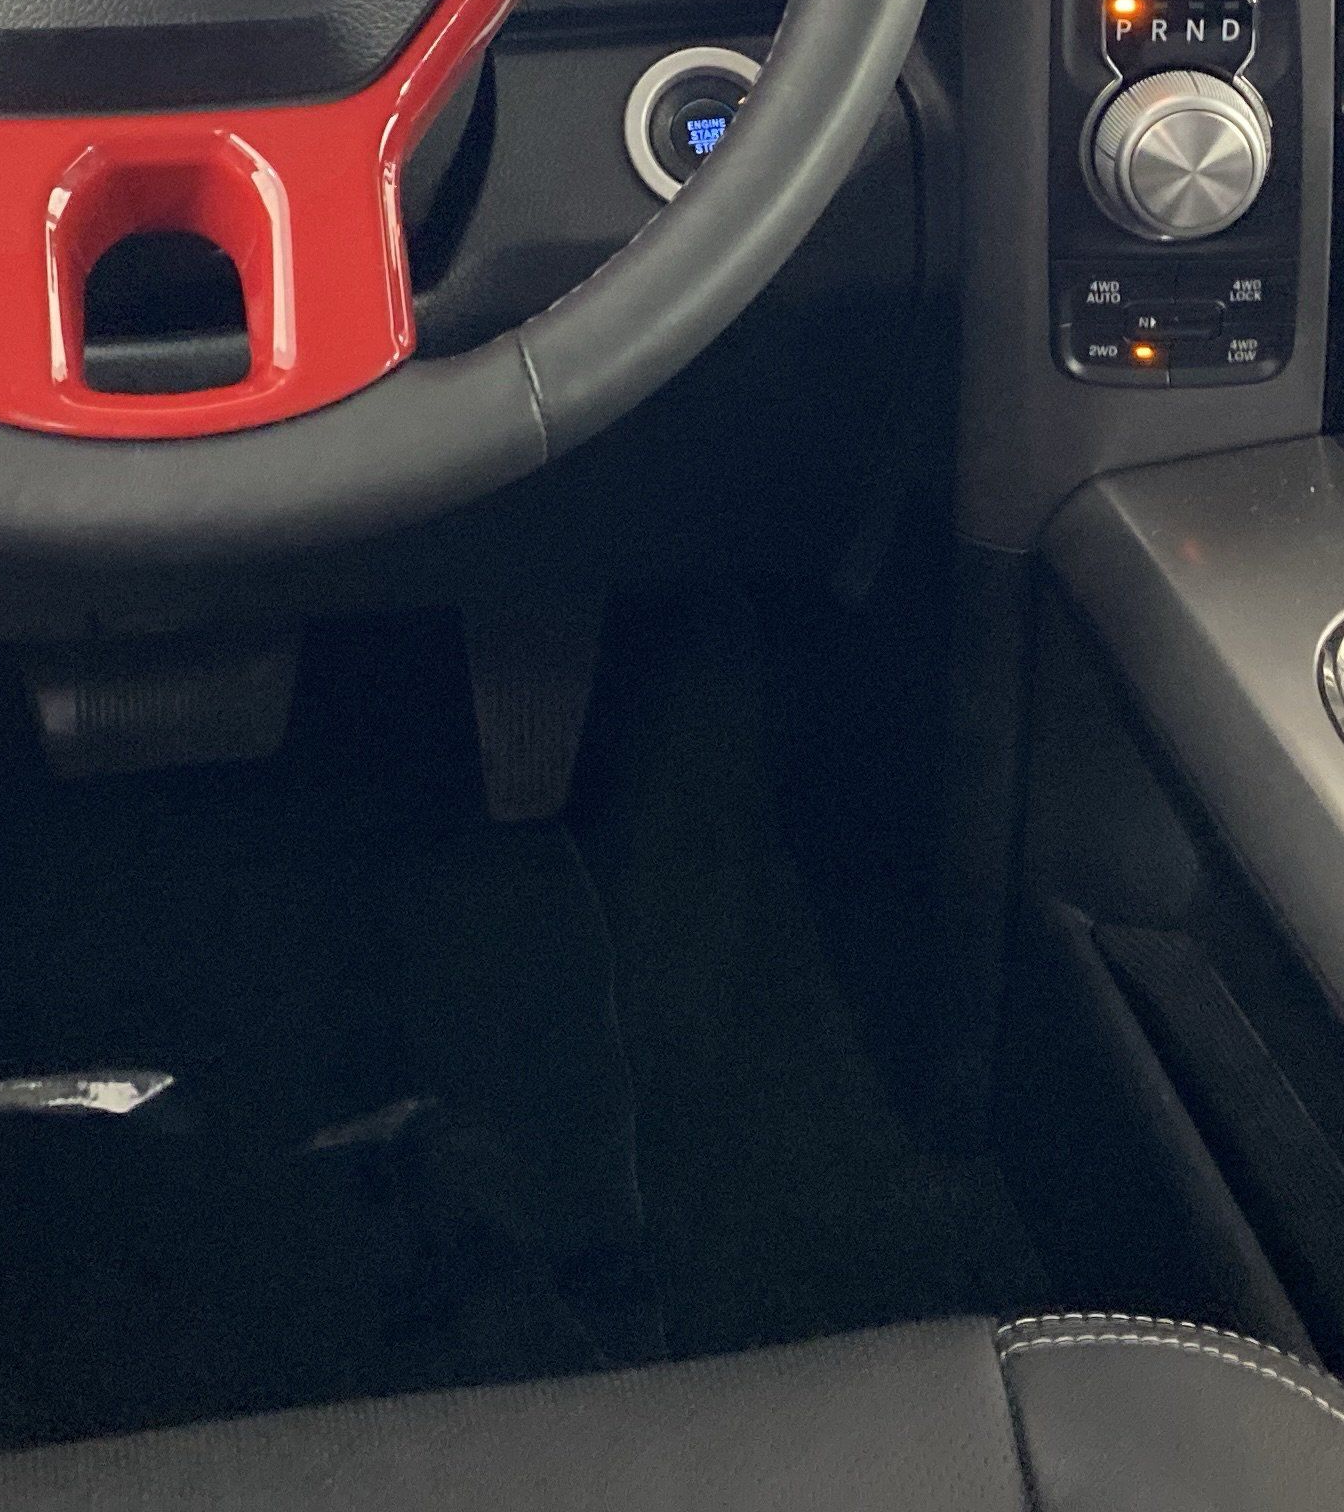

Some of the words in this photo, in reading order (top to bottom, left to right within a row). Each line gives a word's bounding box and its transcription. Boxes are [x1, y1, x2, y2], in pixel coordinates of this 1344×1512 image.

[1116, 19, 1133, 42] P
[1151, 19, 1168, 42] R
[1186, 18, 1205, 42] N
[1222, 19, 1242, 42] D
[687, 118, 726, 131] ENGINE
[1086, 291, 1121, 304] AUTO
[1229, 290, 1262, 302] LOCK
